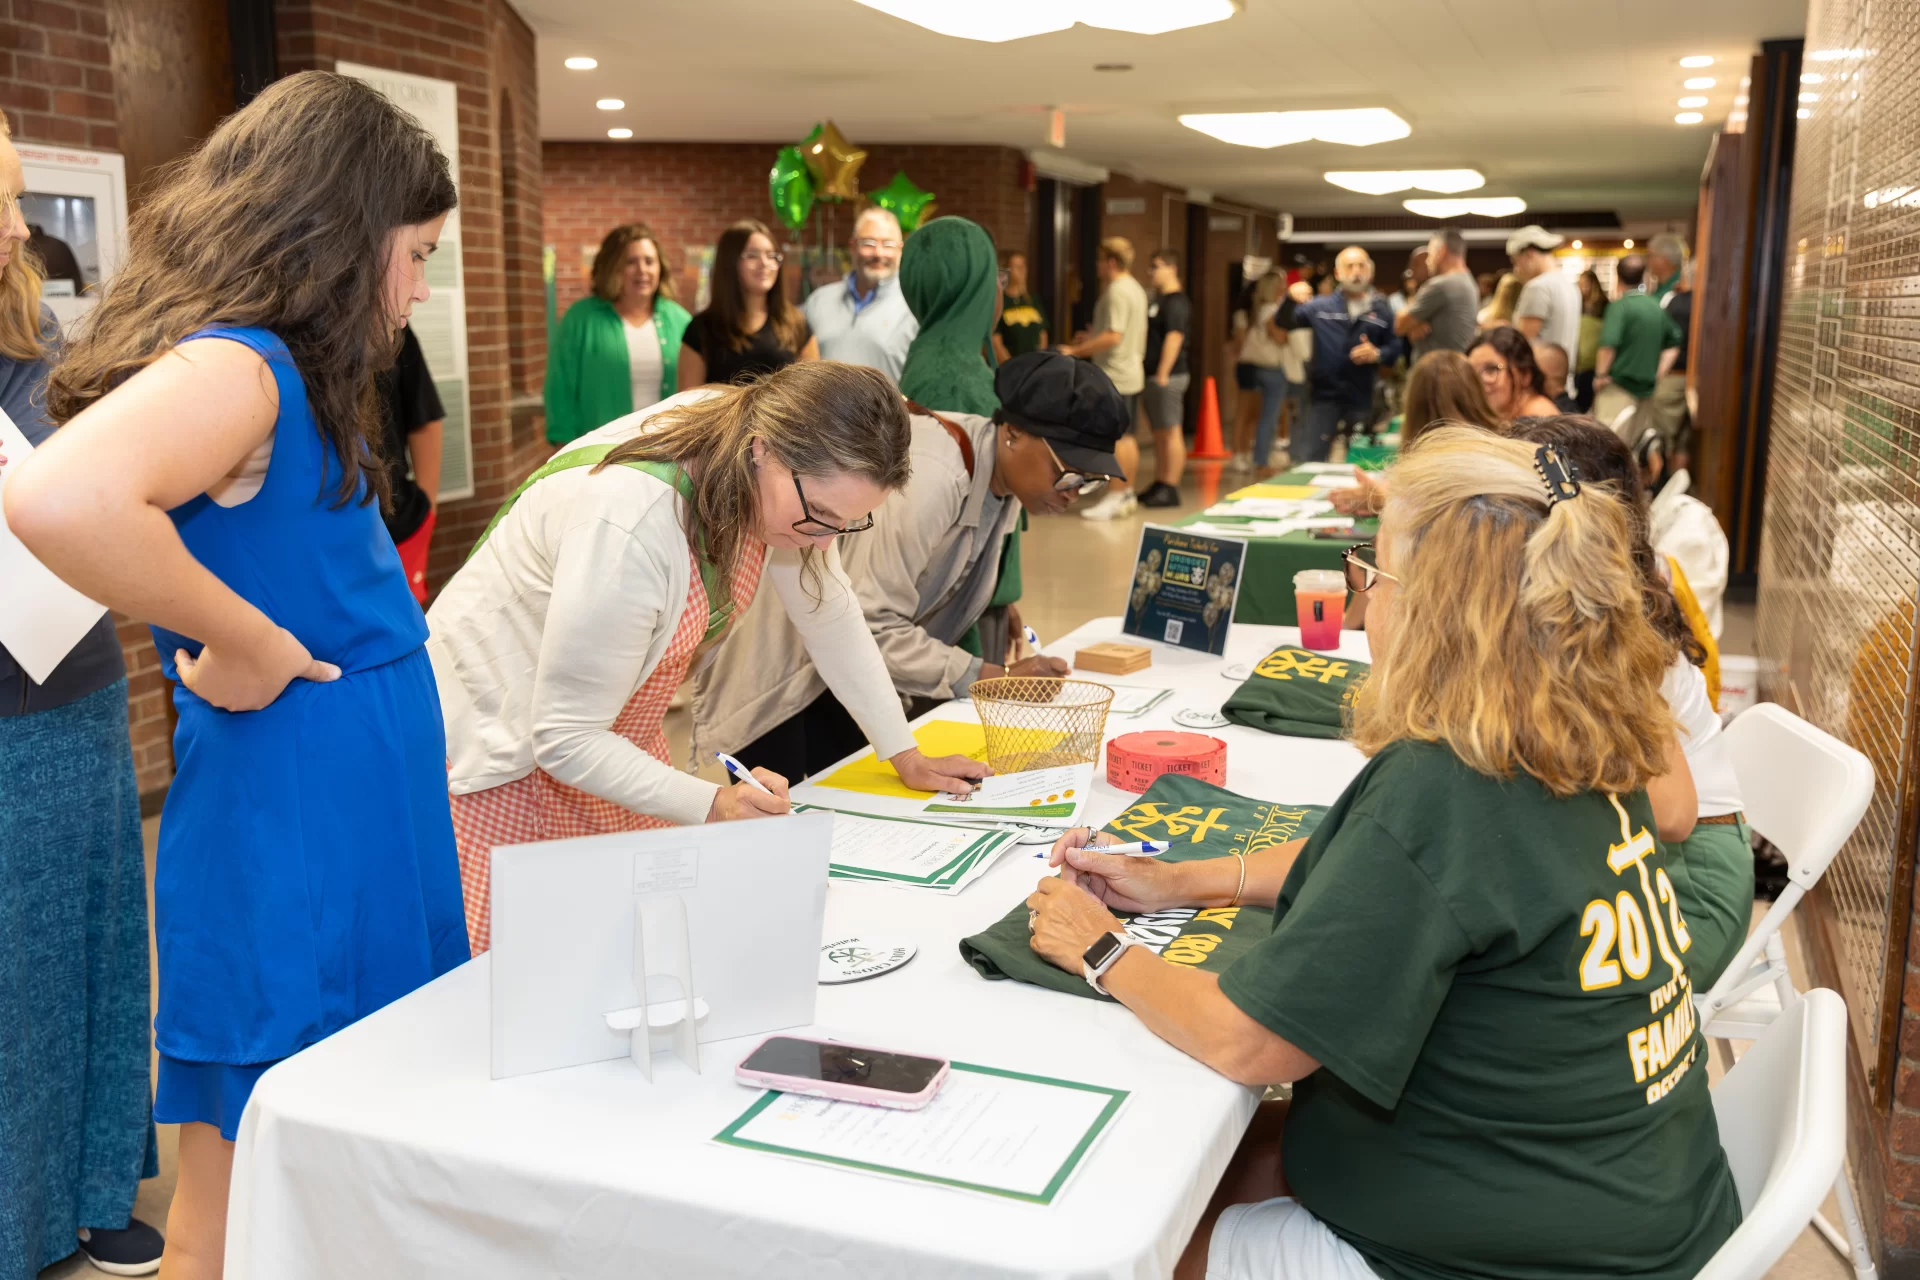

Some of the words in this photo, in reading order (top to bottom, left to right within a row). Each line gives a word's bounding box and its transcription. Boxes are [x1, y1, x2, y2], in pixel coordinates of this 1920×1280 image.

[1132, 760, 1152, 772] TICKET
[1166, 763, 1191, 773] TICKET
[1627, 978, 1696, 1083] FAMILY
